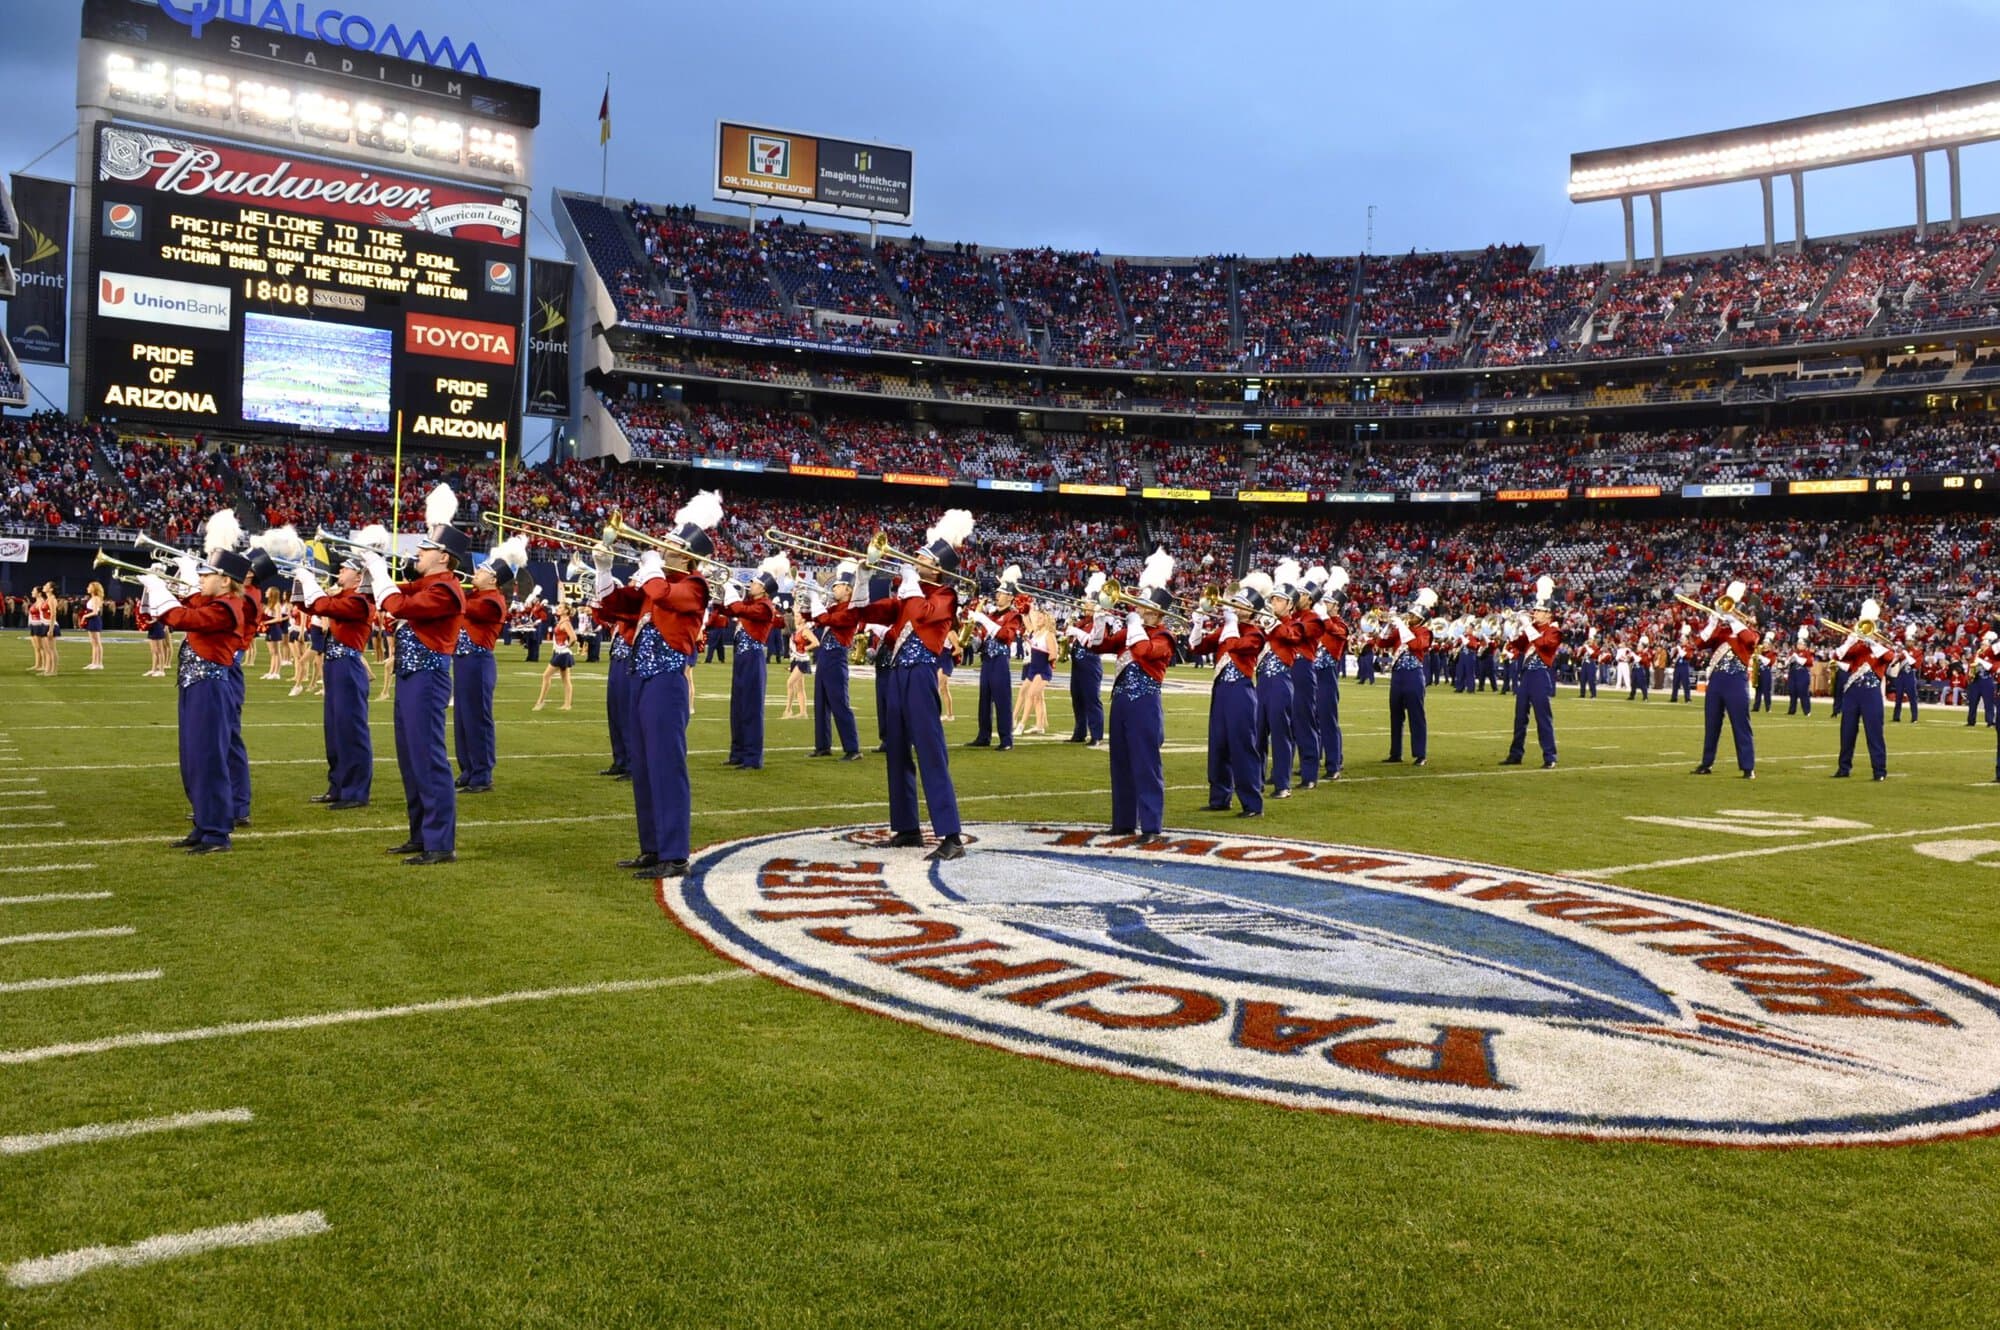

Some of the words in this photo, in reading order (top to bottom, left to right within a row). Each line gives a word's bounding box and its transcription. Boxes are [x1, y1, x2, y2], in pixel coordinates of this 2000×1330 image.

[158, 0, 488, 77] QUALCOMM
[231, 35, 462, 96] STADIUM
[142, 147, 430, 209] Budweiser
[742, 179, 776, 190] THANK
[820, 168, 857, 184] Imaging
[859, 174, 907, 189] Healthcare
[825, 188, 840, 197] Your
[841, 189, 867, 200] Partner
[868, 193, 875, 201] in
[877, 196, 899, 205] Health
[240, 209, 324, 235] WELCOME
[335, 223, 358, 241] TO
[368, 229, 403, 247] THE
[434, 210, 485, 227] American
[488, 211, 520, 227] Lager
[110, 228, 135, 238] pepsi
[170, 214, 258, 241] PACIFIC
[268, 229, 317, 250] LIFE
[327, 239, 407, 263] HOLIDAY
[416, 252, 461, 272] BOWL
[181, 234, 259, 256] PRE-GAME
[267, 247, 305, 263] SHOW
[312, 254, 393, 275] PRESENTED
[400, 266, 418, 280] BY
[425, 270, 452, 284] THE
[14, 268, 64, 289] Sprint
[161, 245, 221, 266] SYCUAN
[229, 255, 268, 272] BAND
[275, 261, 295, 276] OF
[303, 266, 331, 282] THE
[338, 270, 410, 292] KUMEYAAY
[416, 282, 468, 300] NATION
[133, 292, 228, 316] UnionBank
[245, 278, 309, 306] 18:08
[314, 292, 364, 307] SYCUAN
[411, 325, 510, 355] TOYOTA
[529, 336, 568, 354] Sprint
[132, 343, 195, 366] PRIDE
[149, 367, 176, 384] OF
[104, 384, 218, 414] ARIZONA
[436, 378, 488, 398] PRIDE
[450, 399, 473, 415] OF
[413, 415, 506, 441] ARIZONA
[791, 465, 823, 476] WELLS
[825, 469, 857, 478] FARGO
[1499, 490, 1532, 500] WELLS
[1534, 488, 1567, 498] FARGO
[1702, 484, 1755, 496] GEICO
[1025, 828, 1410, 874] BOWL
[746, 857, 922, 923] LIFE
[1364, 870, 1963, 1030] HOLIDAY
[803, 918, 1518, 1092] PACIFIC
